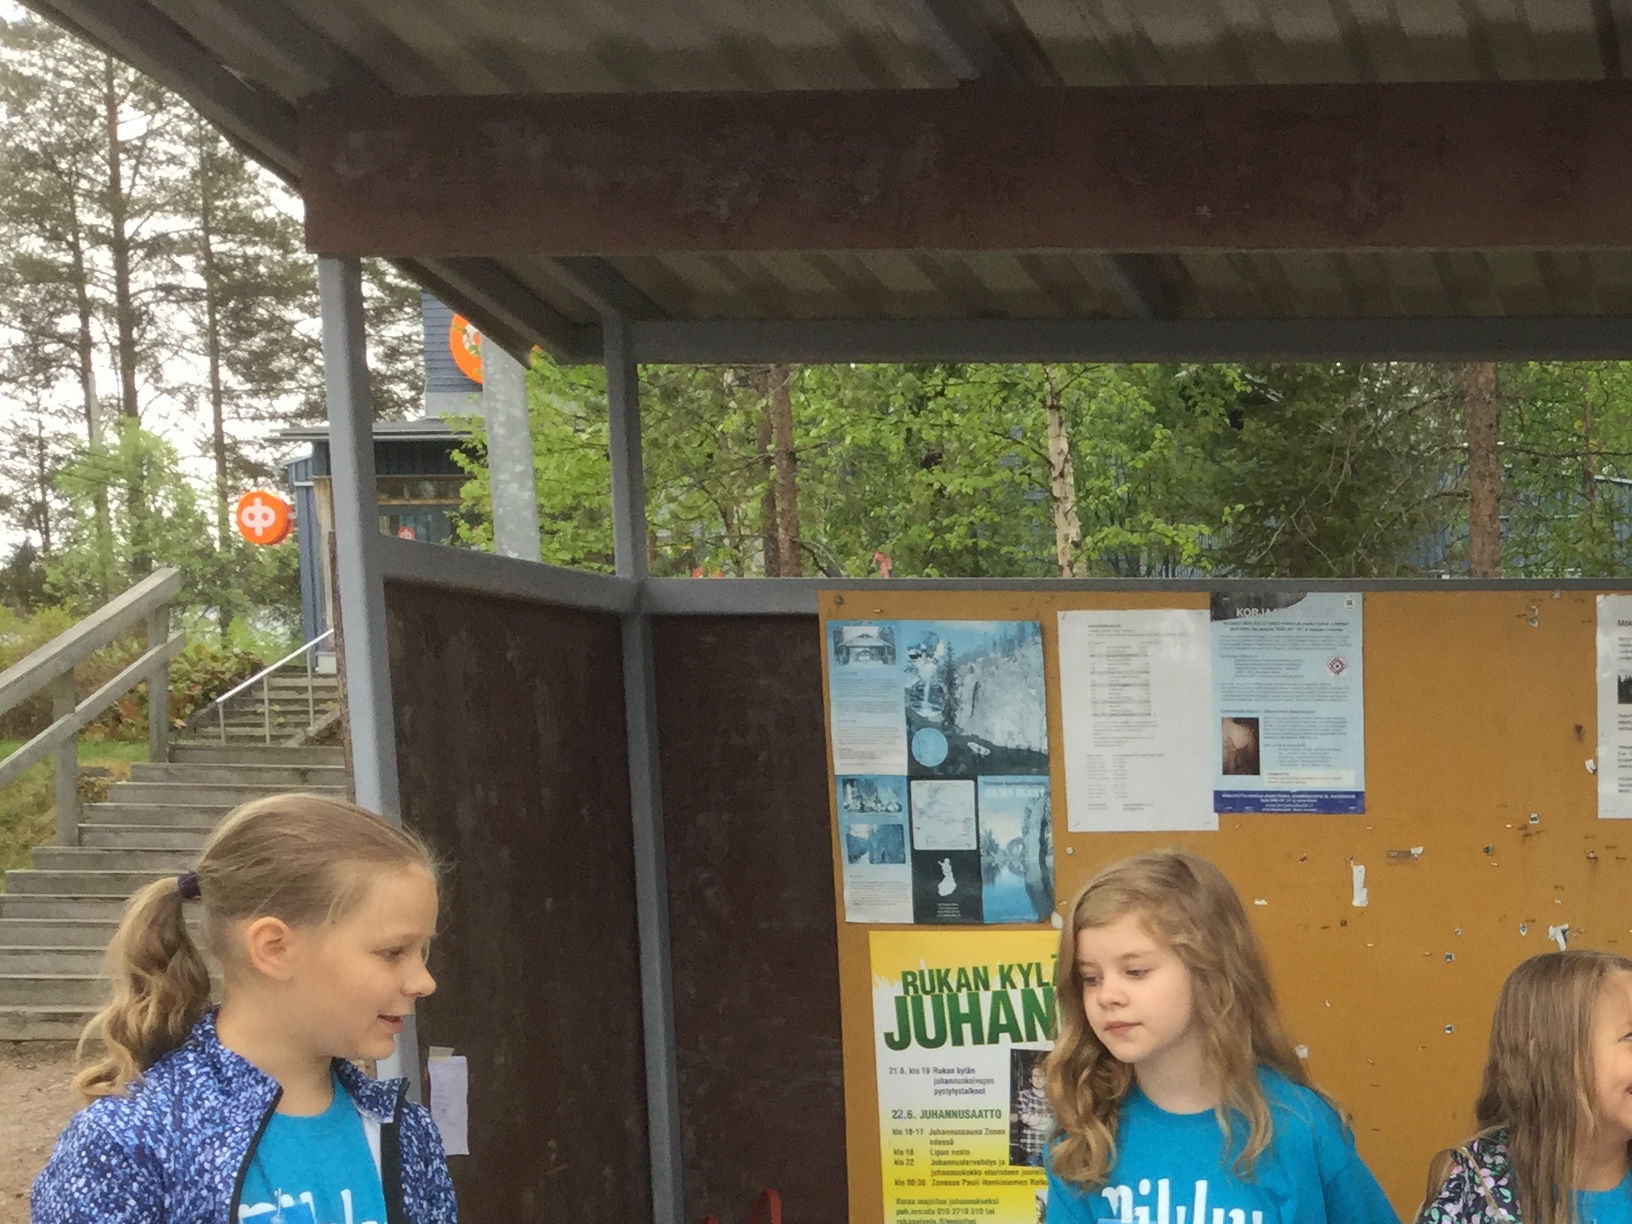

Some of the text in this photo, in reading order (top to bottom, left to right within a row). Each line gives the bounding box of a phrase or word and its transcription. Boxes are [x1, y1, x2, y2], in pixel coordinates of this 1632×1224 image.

[901, 965, 992, 996] RUKAN
[891, 1109, 1002, 1119] 22.6. JUHANNUSAATTO
